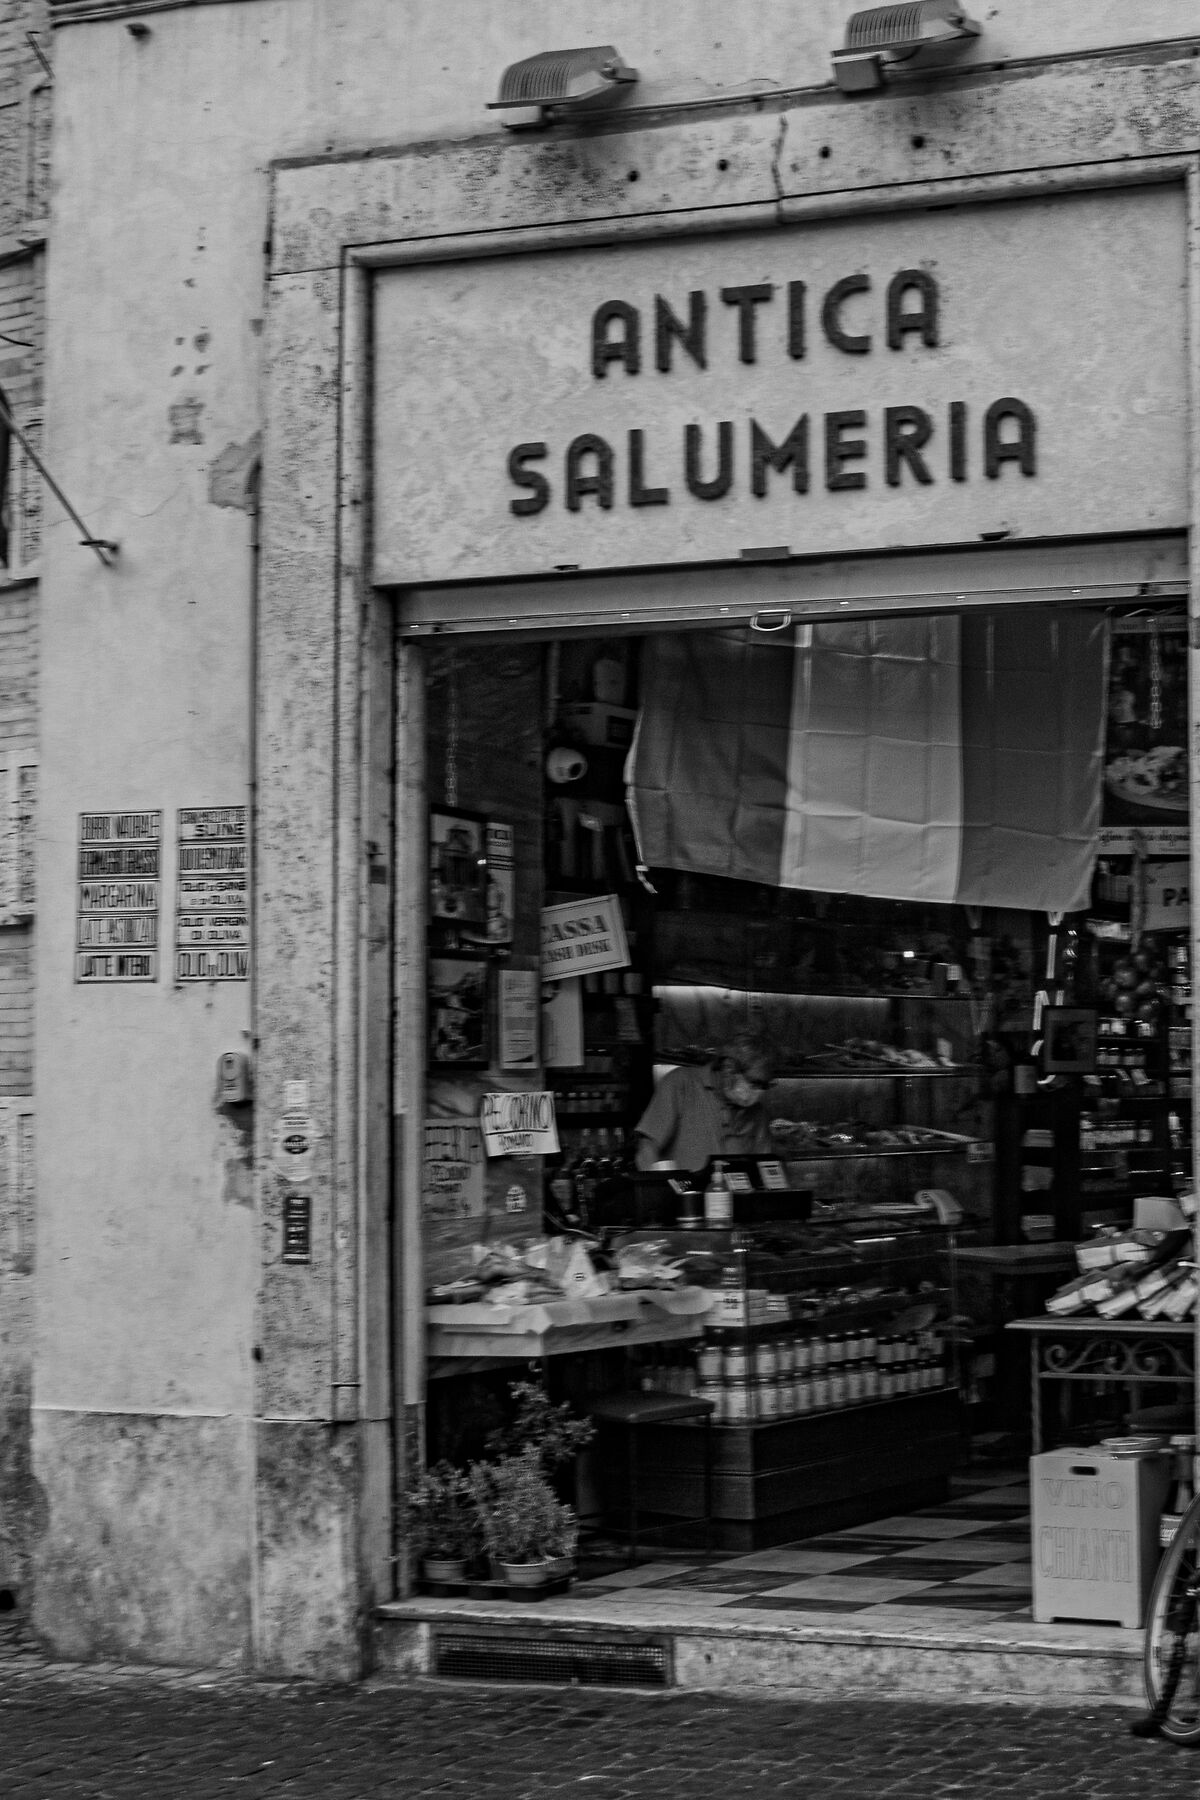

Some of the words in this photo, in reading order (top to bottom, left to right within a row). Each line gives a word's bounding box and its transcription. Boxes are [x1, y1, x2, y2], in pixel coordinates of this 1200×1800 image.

[591, 268, 940, 377] ANTICA
[507, 397, 1036, 516] SALUMERIA
[80, 884, 158, 907] MARGARINA
[483, 1095, 554, 1130] PECORINO
[1040, 1478, 1128, 1510] VINO
[1039, 1525, 1134, 1583] CHIANTI
